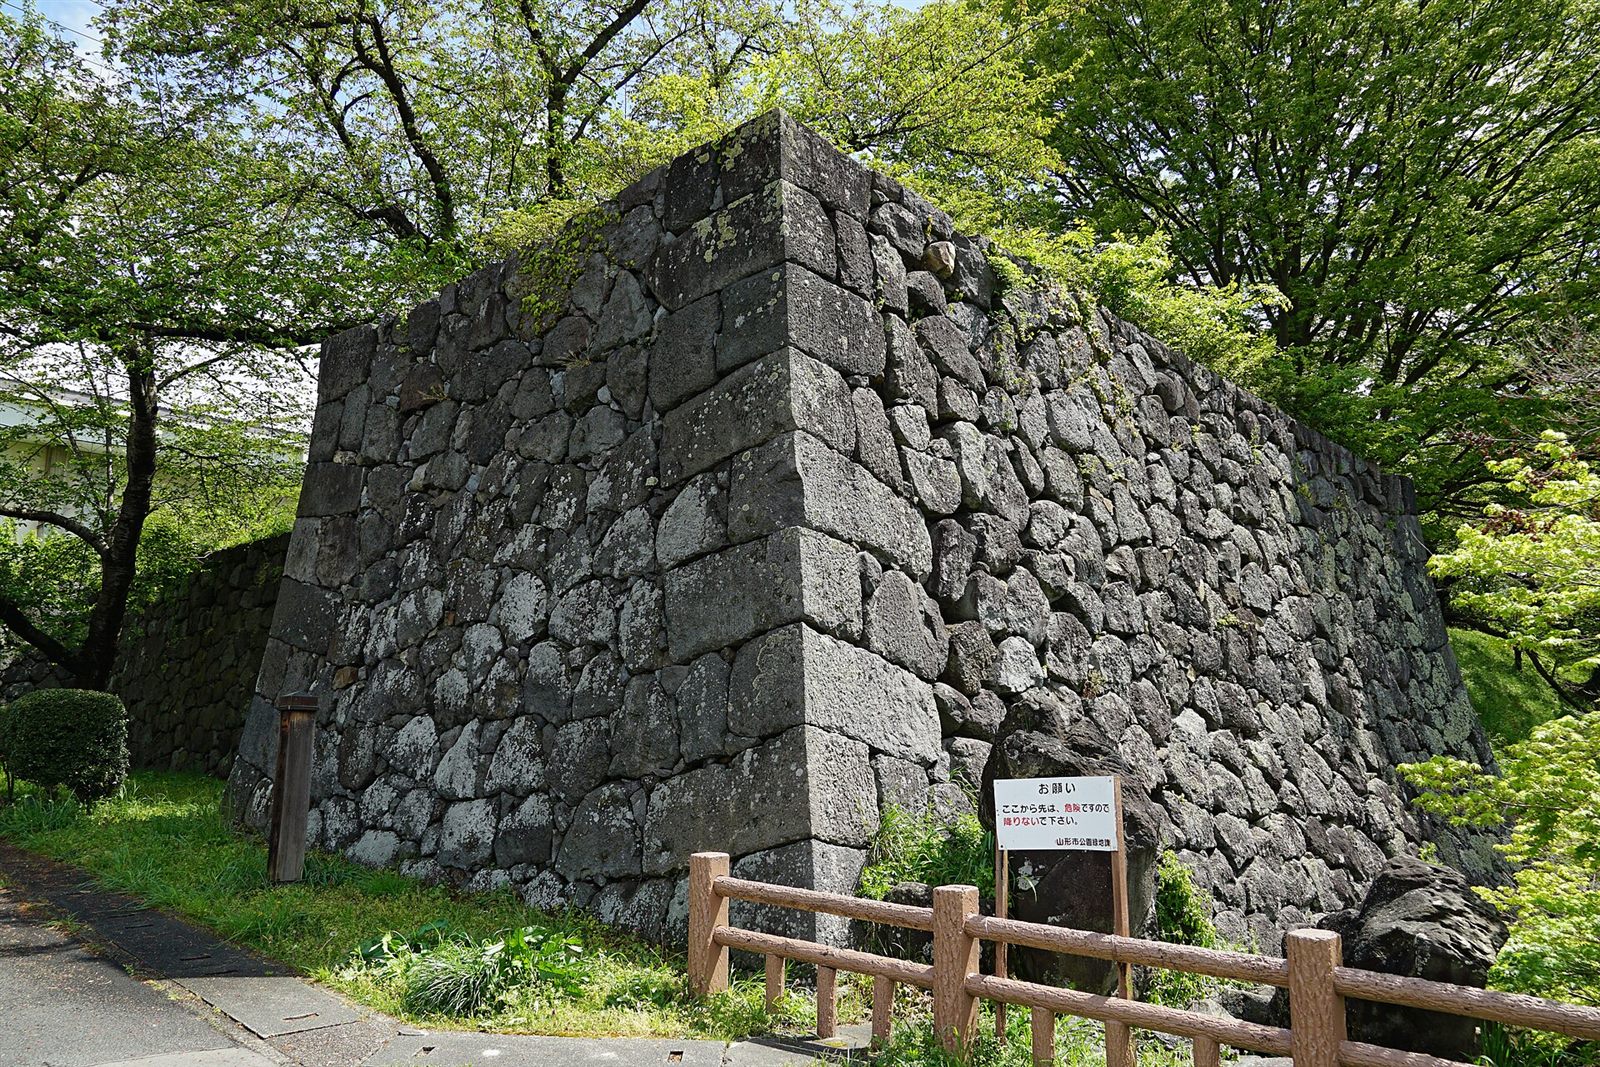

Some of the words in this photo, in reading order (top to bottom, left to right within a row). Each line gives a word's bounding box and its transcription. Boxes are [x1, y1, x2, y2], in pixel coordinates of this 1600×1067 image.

[1038, 782, 1076, 794] お願い
[1002, 803, 1110, 814] ここから先は、危険ですので
[1003, 816, 1078, 826] 降りないで下さい。
